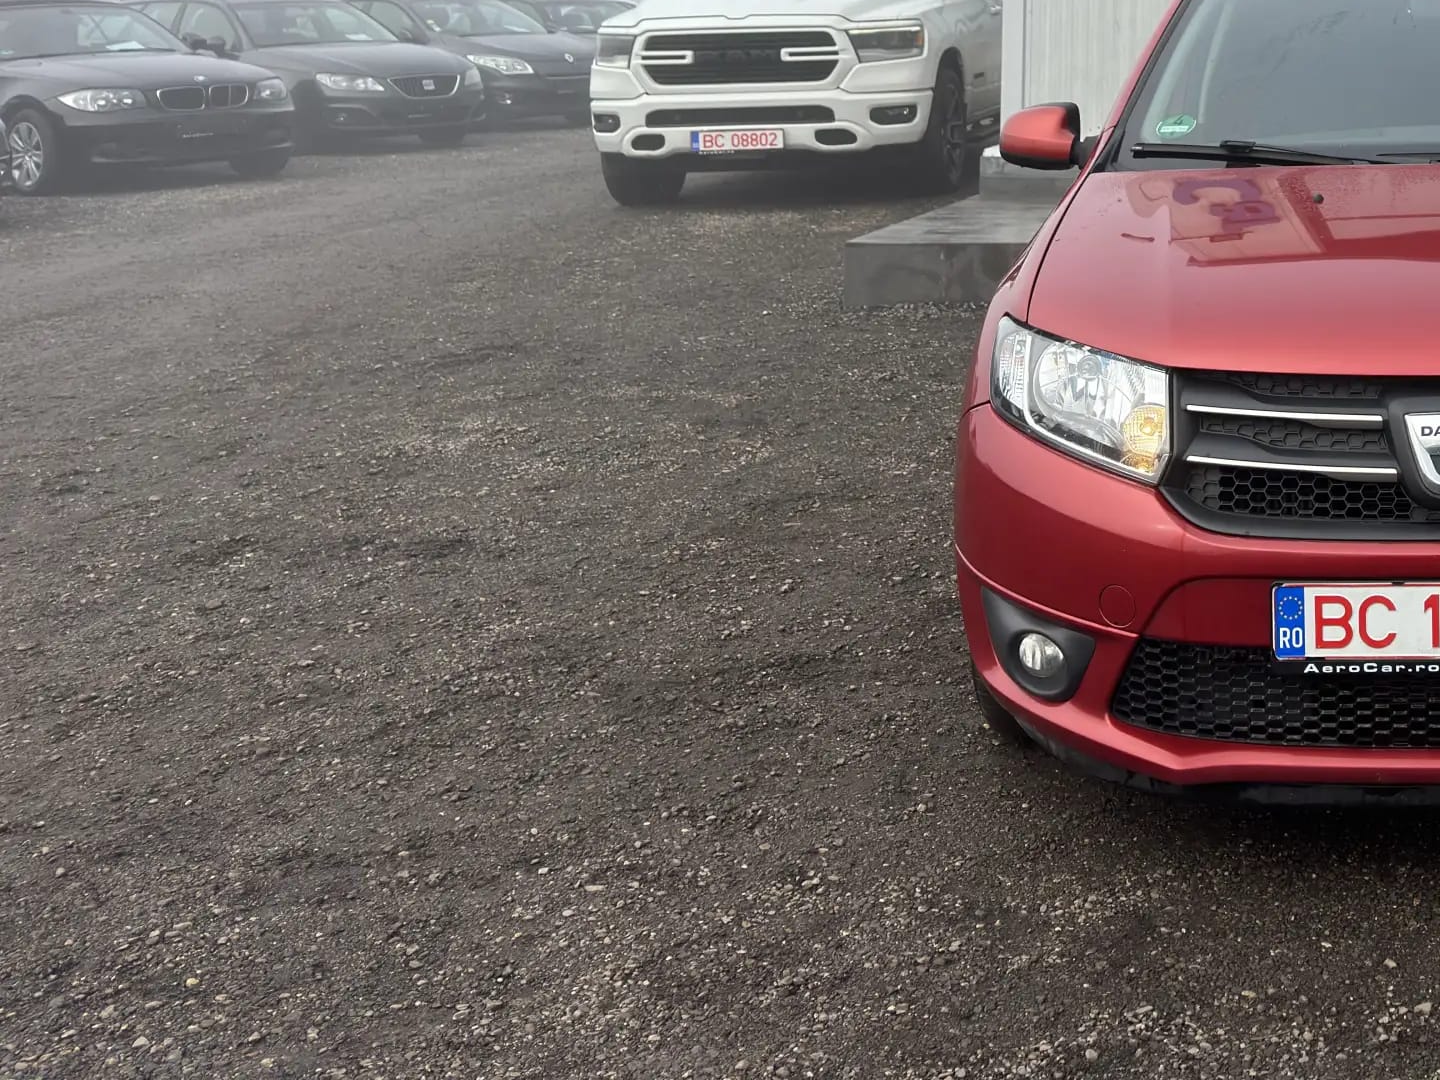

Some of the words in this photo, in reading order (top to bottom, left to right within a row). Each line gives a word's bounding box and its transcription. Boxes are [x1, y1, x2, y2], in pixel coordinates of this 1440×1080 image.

[703, 133, 725, 148] BC
[731, 132, 778, 148] 08802
[1279, 626, 1303, 649] RO
[1314, 594, 1398, 649] BC
[1303, 663, 1440, 674] AeroCar.ro
